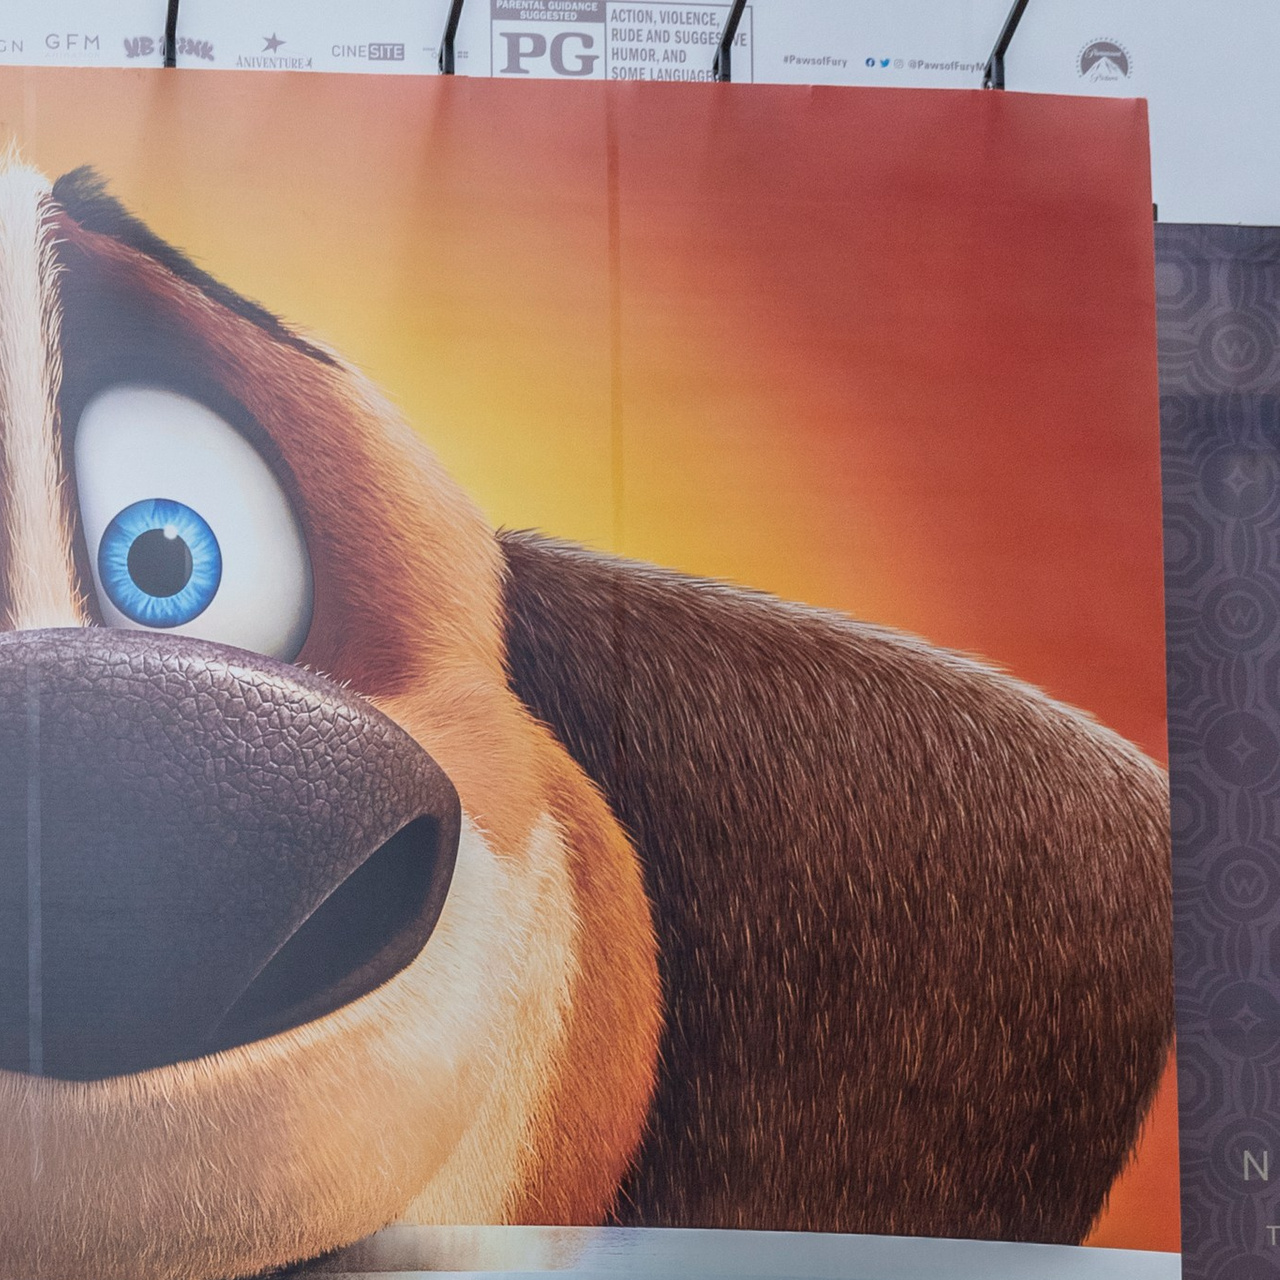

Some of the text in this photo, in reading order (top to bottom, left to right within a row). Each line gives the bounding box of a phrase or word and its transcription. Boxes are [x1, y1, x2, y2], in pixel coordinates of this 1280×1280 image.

[496, 0, 598, 11] PARENTAL GUIDANCE
[520, 11, 577, 20] SUGGESTED
[610, 9, 719, 27] ACTION, VIOLENCE,
[45, 33, 100, 50] GFM
[612, 28, 748, 46] RUDE AND SUGGESVE
[331, 43, 405, 60] CINESITE
[499, 32, 600, 76] PG
[611, 48, 686, 64] HUMOR, AND
[783, 55, 847, 68] #PawsofFury
[907, 59, 987, 73] @PawsofFuryM
[611, 66, 645, 80] SOME
